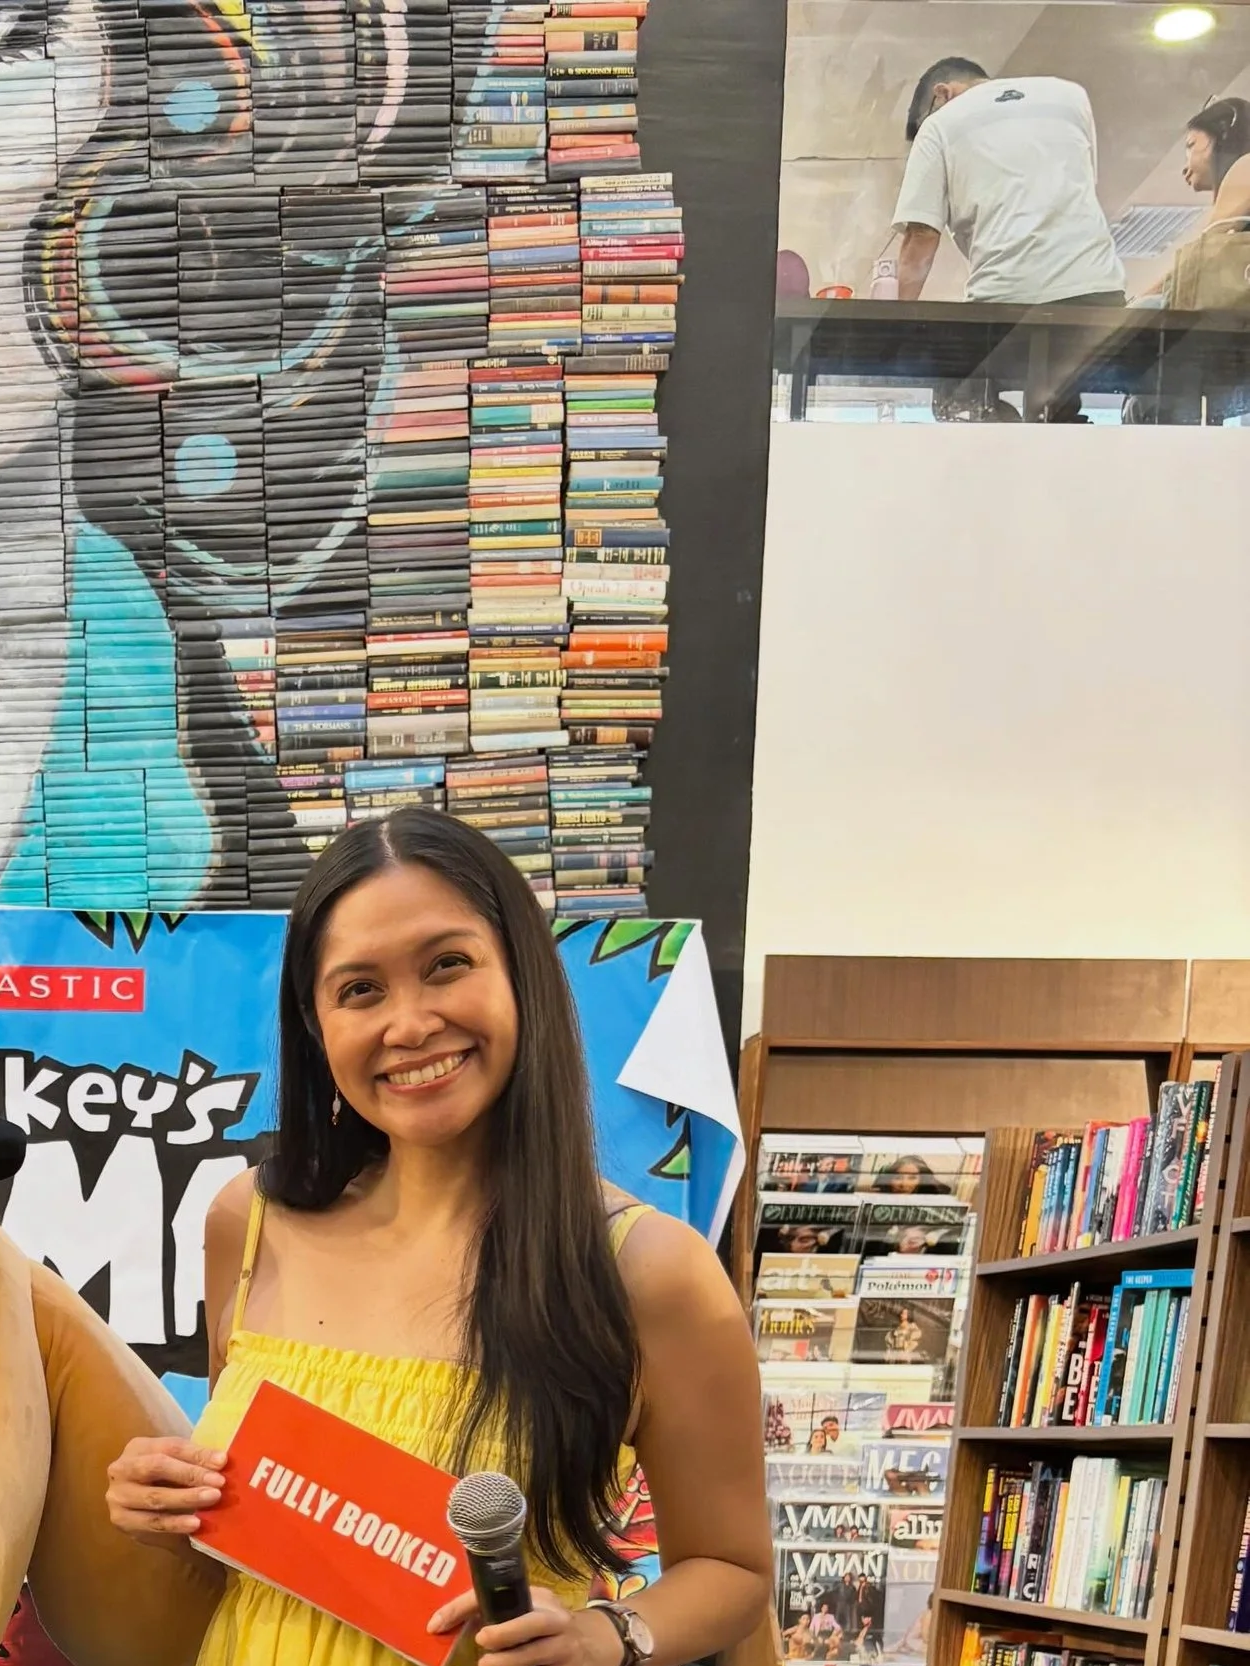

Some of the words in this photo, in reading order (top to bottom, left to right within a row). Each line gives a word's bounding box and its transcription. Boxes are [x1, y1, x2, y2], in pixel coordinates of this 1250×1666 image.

[569, 582, 611, 597] Oprah
[293, 723, 308, 731] THE
[311, 722, 351, 730] NORMANS
[760, 1256, 818, 1291] art
[866, 1279, 934, 1292] Pokémon
[248, 1455, 340, 1525] FULLY
[332, 1500, 457, 1588] BOOKED
[784, 1504, 875, 1537] VMAN
[894, 1514, 943, 1540] allu
[791, 1551, 883, 1585] VMAN
[1230, 1590, 1241, 1612] HART
